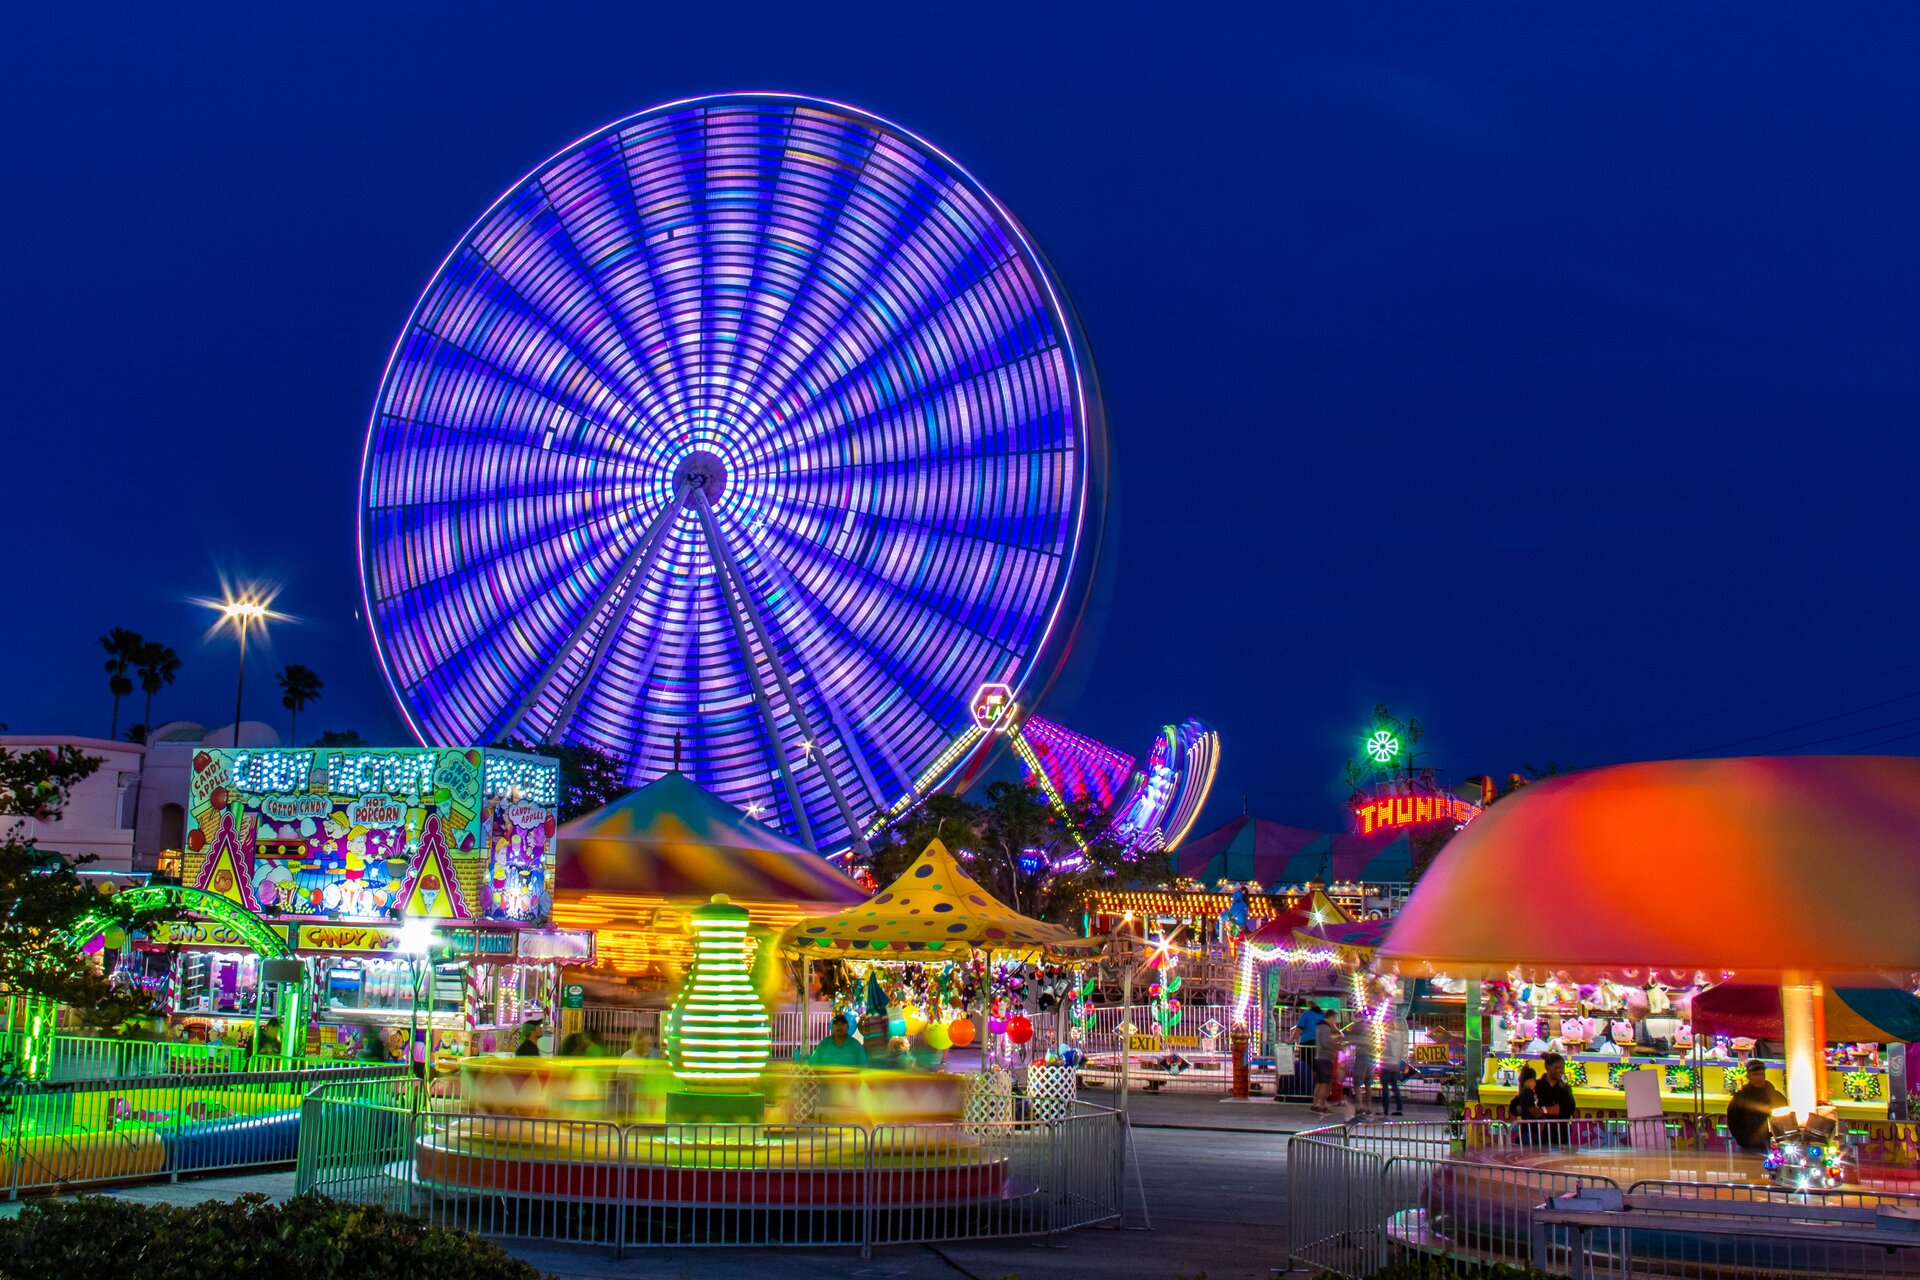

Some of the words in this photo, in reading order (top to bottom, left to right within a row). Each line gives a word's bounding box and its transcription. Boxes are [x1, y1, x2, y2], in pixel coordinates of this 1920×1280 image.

[194, 759, 222, 789] CANDY
[232, 751, 315, 795] CANDY
[328, 751, 439, 797] FACTORY
[450, 761, 471, 784] SNO
[199, 770, 229, 800] APPLES
[438, 770, 470, 801] CONES
[267, 800, 297, 815] COTTON
[300, 800, 327, 815] CANDY
[366, 798, 385, 807] HOT
[512, 806, 531, 817] CANDY
[355, 807, 399, 823] POPCORN
[521, 811, 544, 824] APPLES
[169, 924, 207, 943] SNO
[306, 927, 367, 949] CANDY
[479, 933, 512, 953] DRINKS
[1129, 1036, 1156, 1051] EXIT
[1416, 1046, 1447, 1061] ENTER
